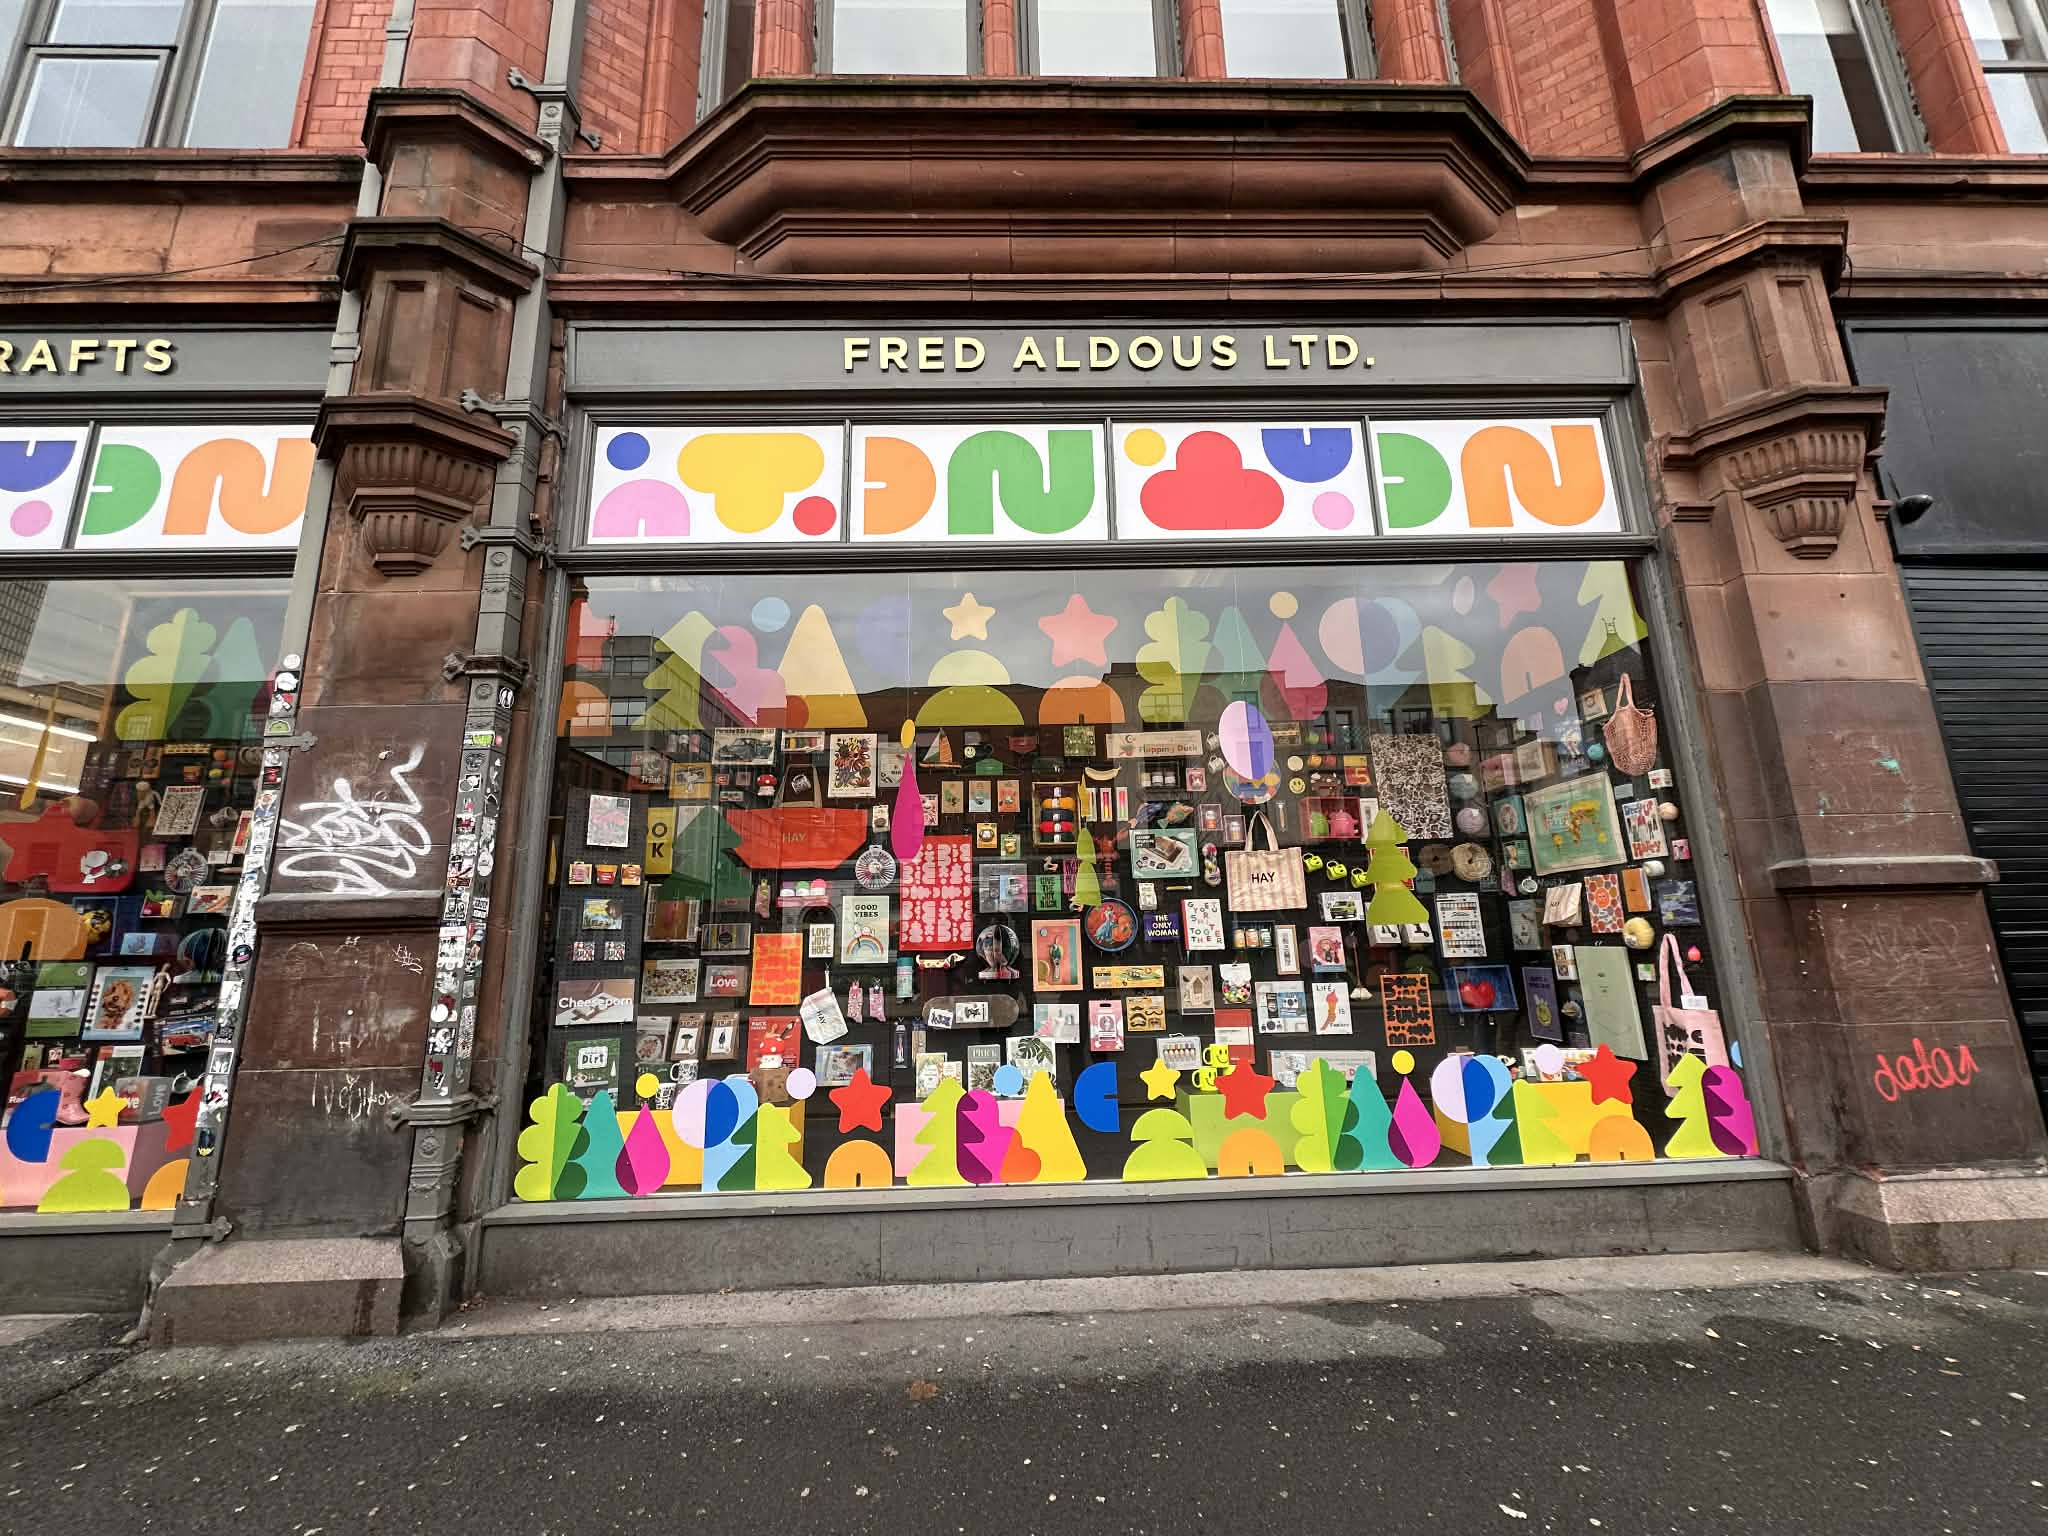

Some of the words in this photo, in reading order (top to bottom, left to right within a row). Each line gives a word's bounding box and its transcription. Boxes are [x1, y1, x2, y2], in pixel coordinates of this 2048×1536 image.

[843, 336, 986, 370] FRED
[1013, 335, 1238, 369] ALDOUS
[1265, 334, 1376, 367] LTD.
[783, 832, 805, 843] HAY
[1251, 872, 1276, 884] HAY
[811, 928, 831, 937] LOVE
[811, 944, 831, 954] HOPE
[710, 976, 738, 987] Love
[1316, 984, 1332, 992] LIFE
[558, 997, 633, 1009] Cheeseporn
[816, 1010, 827, 1025] HAY
[582, 1054, 604, 1064] Dirt
